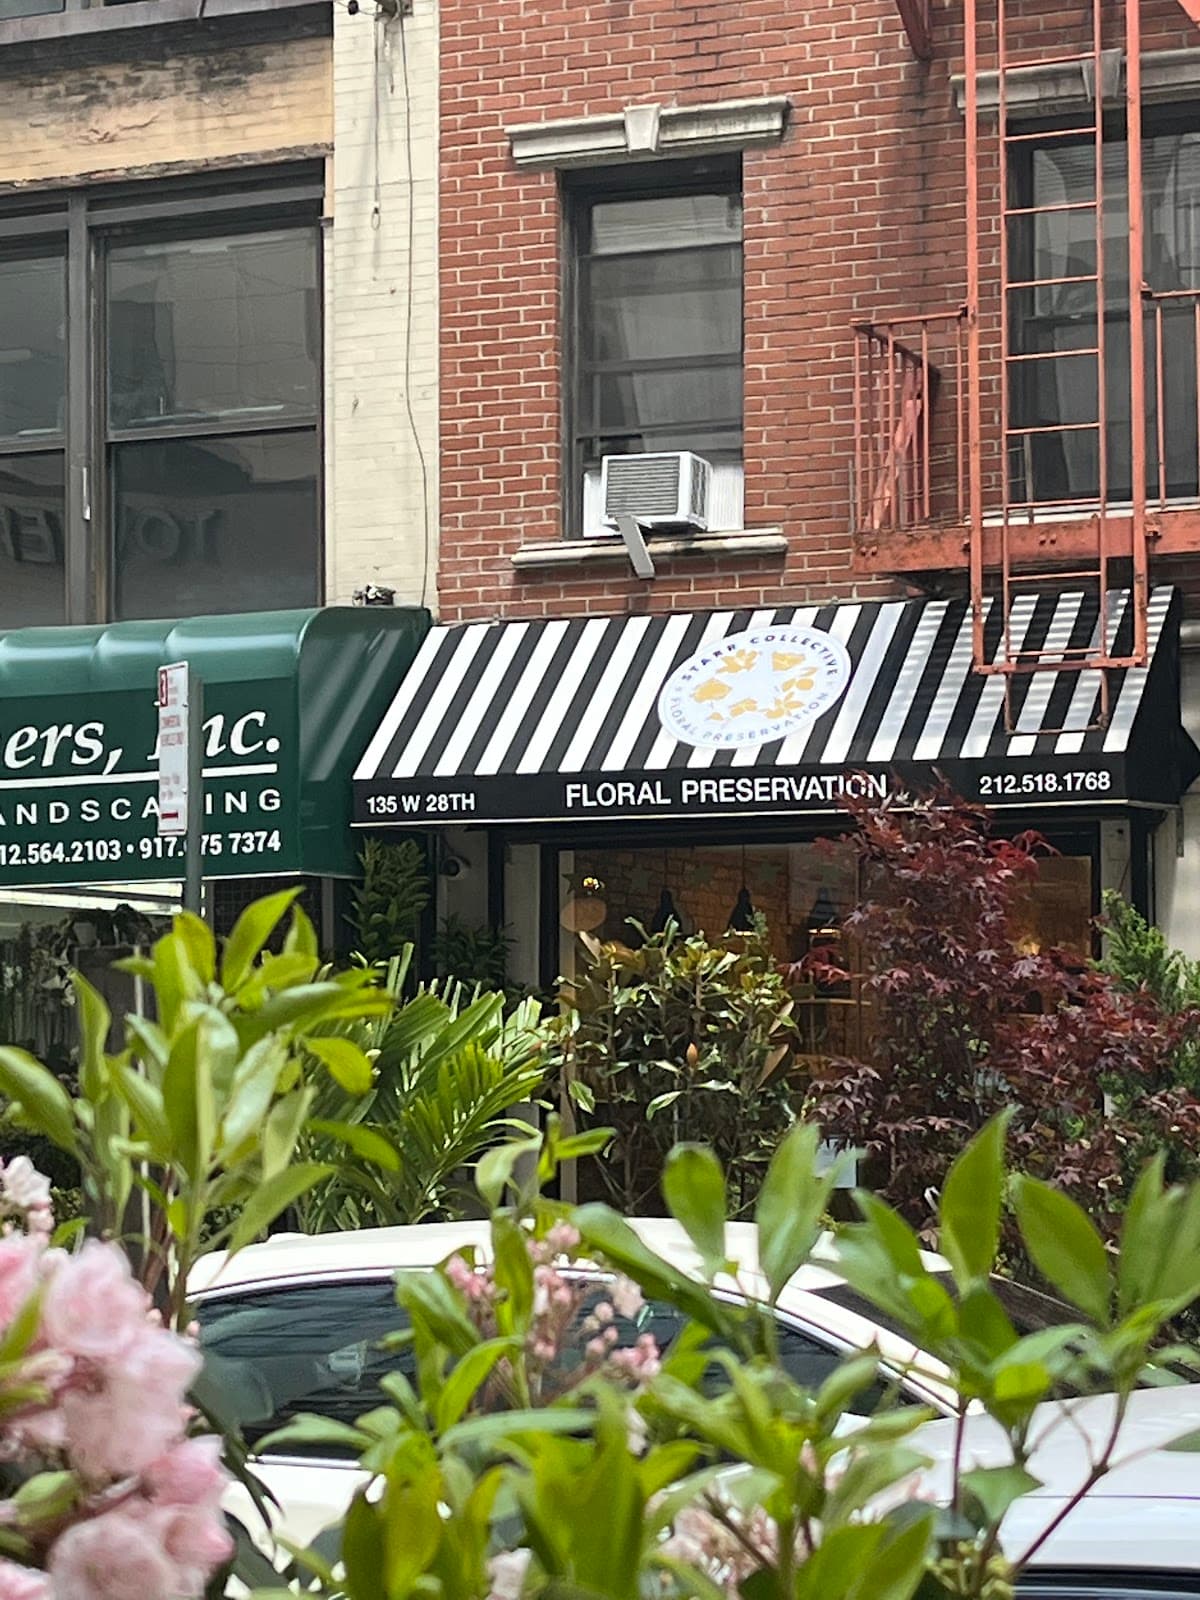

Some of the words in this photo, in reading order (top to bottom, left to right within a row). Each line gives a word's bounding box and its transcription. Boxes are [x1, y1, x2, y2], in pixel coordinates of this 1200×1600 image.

[750, 634, 838, 675] COLLECTIVE
[702, 692, 828, 742] PRESERVATION
[4, 721, 123, 776] ers,
[566, 782, 671, 808] FLORAL
[681, 774, 887, 804] PRESERVATION
[979, 771, 1111, 795] 212.518.1768
[0, 788, 281, 827] NDSCAING
[366, 795, 398, 813] 135
[401, 794, 421, 813] W
[426, 793, 475, 812] 28TH
[139, 833, 222, 859] 917.75
[228, 830, 281, 855] 7374
